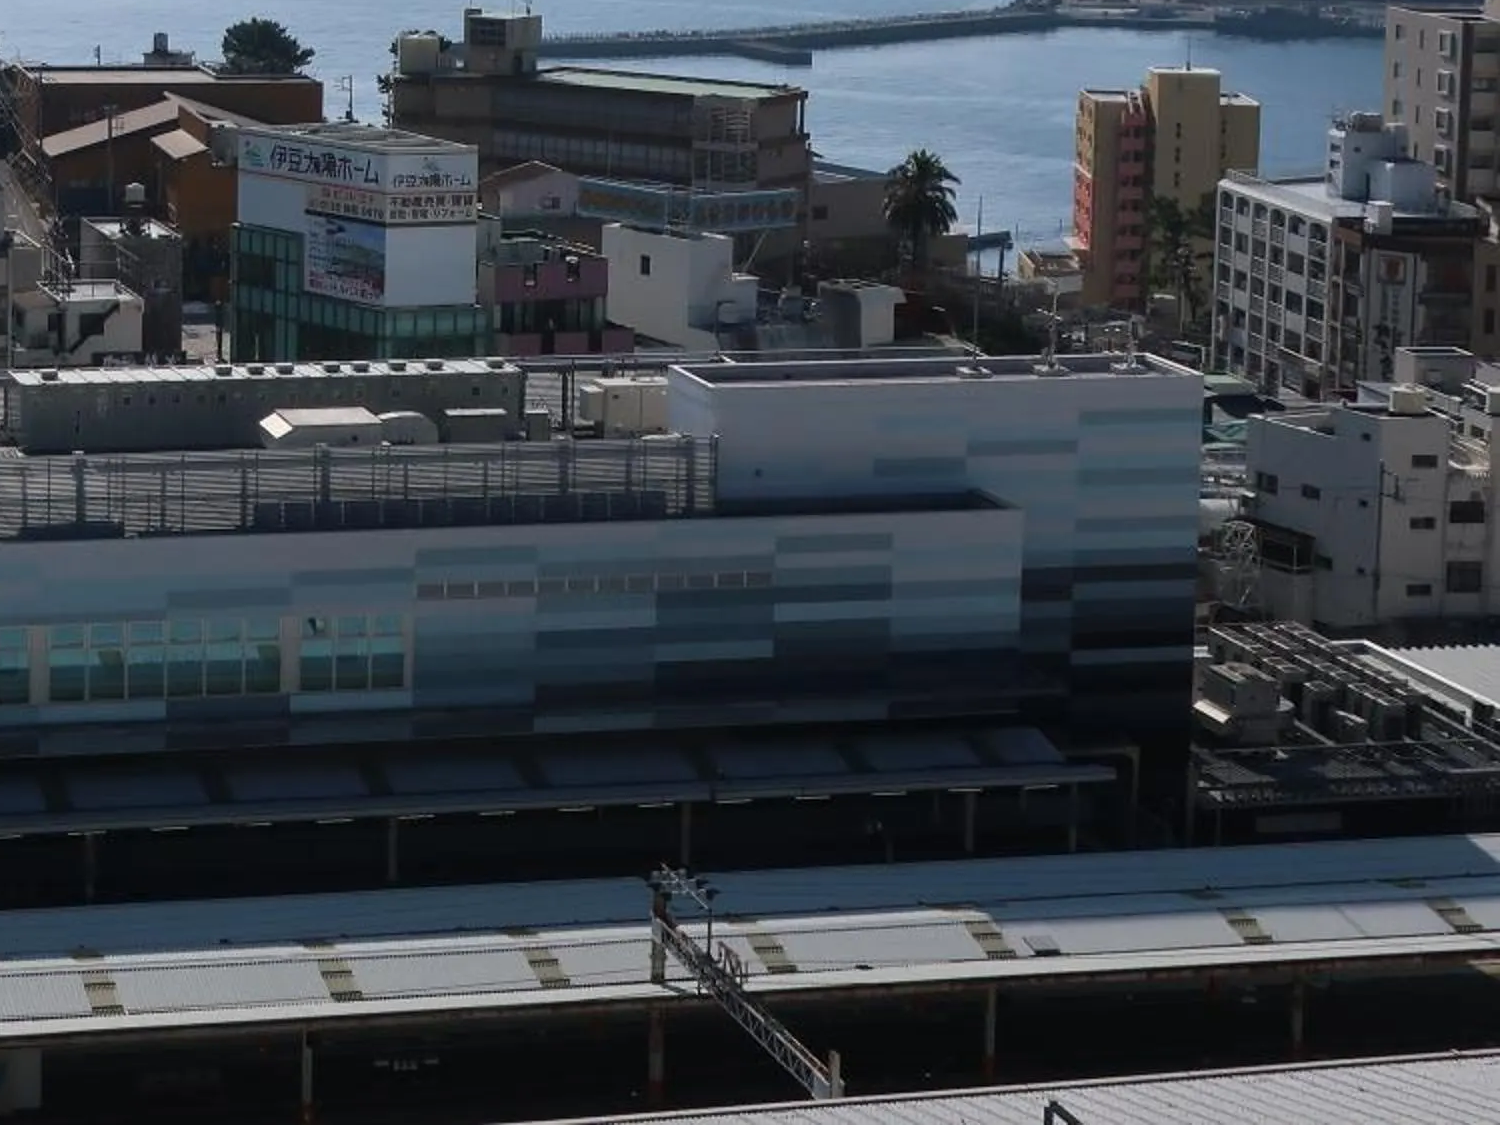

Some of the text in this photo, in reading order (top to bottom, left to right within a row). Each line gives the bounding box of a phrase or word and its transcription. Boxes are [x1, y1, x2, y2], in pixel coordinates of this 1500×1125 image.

[269, 142, 380, 185] 伊豆太陽ホーム
